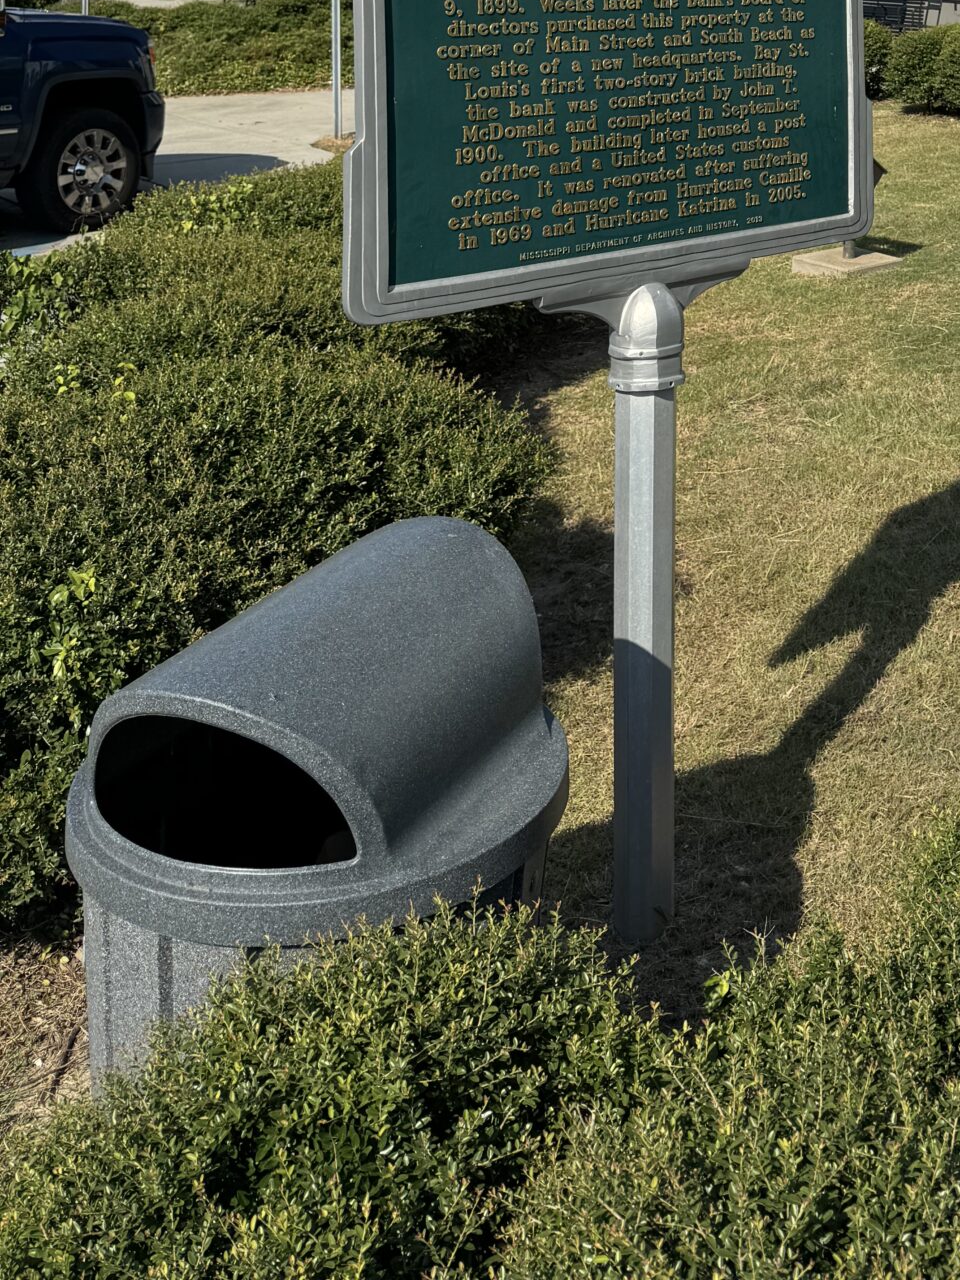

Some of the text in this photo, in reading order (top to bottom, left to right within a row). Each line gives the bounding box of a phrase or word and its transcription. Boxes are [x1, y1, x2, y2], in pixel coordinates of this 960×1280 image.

[444, 0, 463, 16] 9,
[448, 8, 804, 36] directors purchased this property at the
[437, 26, 815, 59] corner of Main Street and South Beach as
[447, 43, 809, 80] the site of a new headquarters. Bay St.
[465, 80, 529, 100] Louis's
[541, 76, 584, 94] first
[594, 72, 677, 90] two-story
[685, 67, 724, 83] brick
[466, 79, 797, 120] the bank was constructed by John T.
[456, 114, 806, 165] 1900. The building later housed a post
[462, 98, 800, 143] McDonald and completed in September
[451, 152, 808, 208] office. It was renovated after suffering
[480, 135, 789, 183] office and a United States customs
[448, 168, 811, 230] extensive damage from Hurricane Camille
[459, 186, 806, 250] in 1969 and Hurricane Katrina in 2005.
[520, 246, 571, 261] MISSISSIPPI
[576, 237, 628, 252] DEPARTMENT
[633, 235, 642, 243] OF
[647, 227, 684, 240] ARCHIVES
[688, 225, 702, 234] AND
[747, 216, 763, 224] 2013
